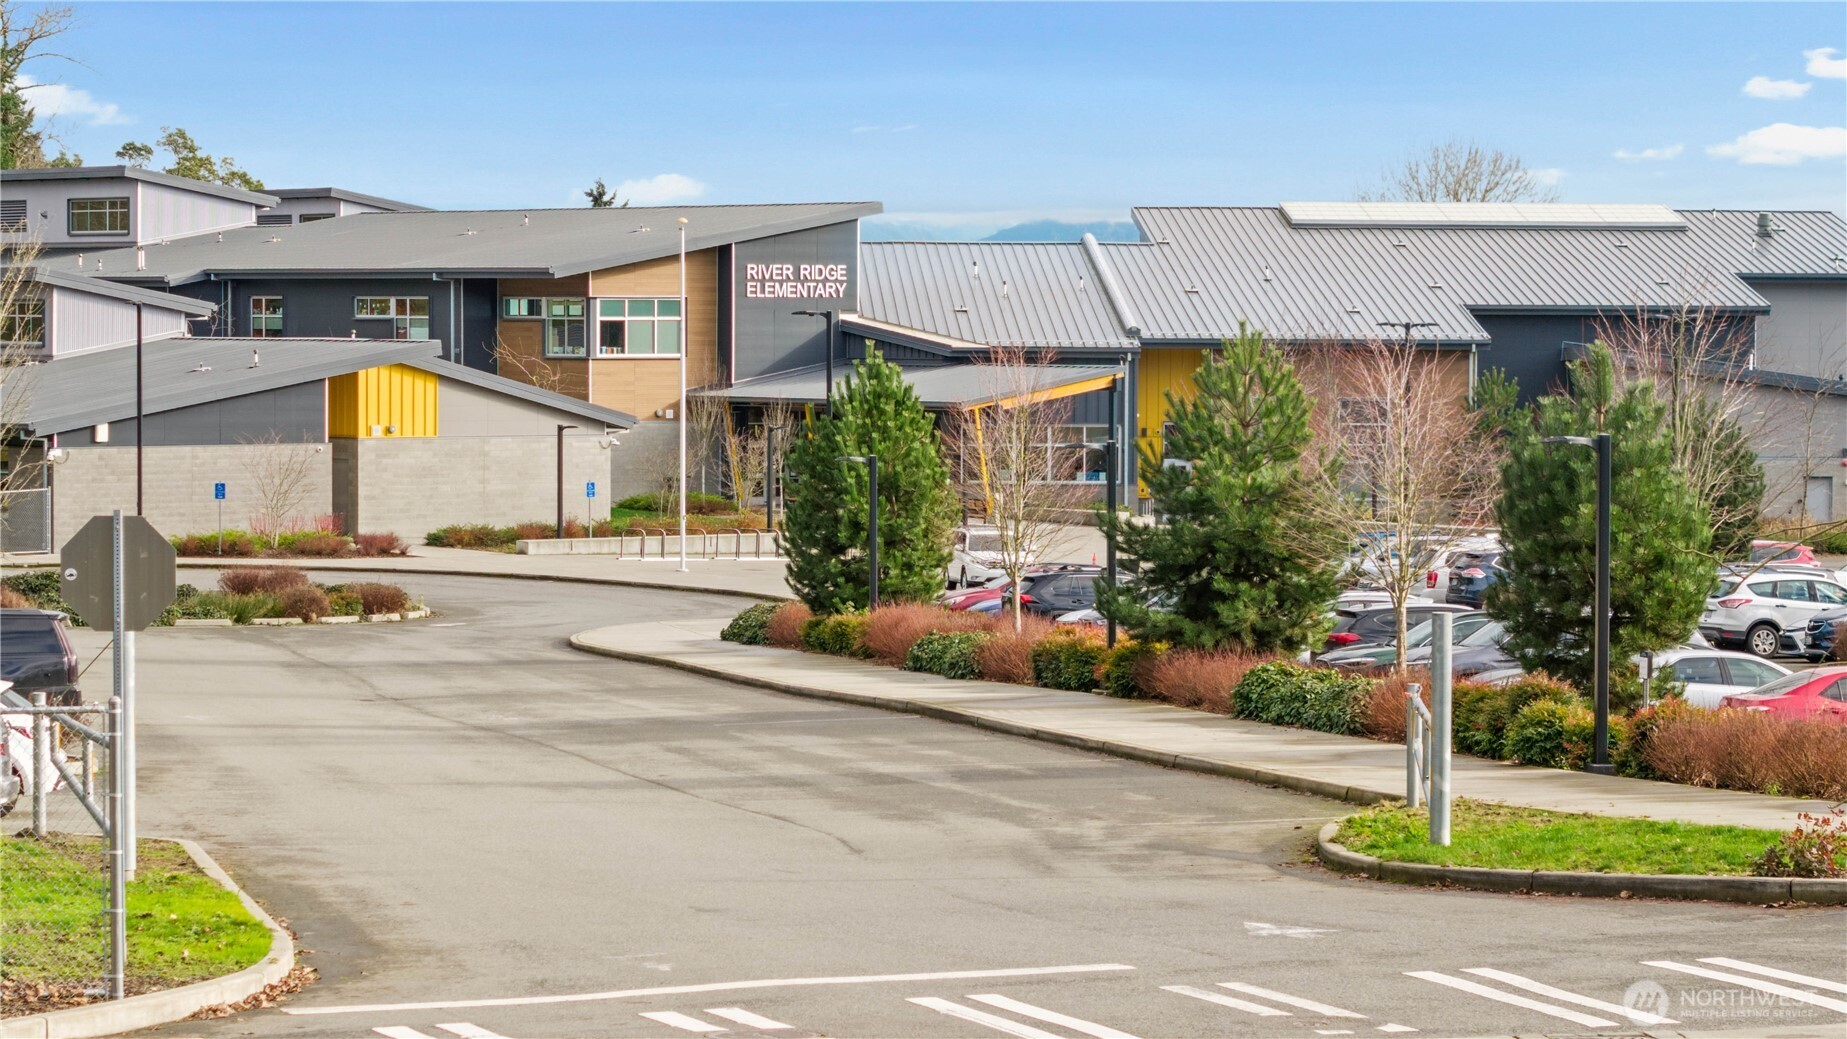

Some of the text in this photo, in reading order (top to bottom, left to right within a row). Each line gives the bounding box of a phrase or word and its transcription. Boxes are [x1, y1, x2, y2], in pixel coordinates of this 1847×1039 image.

[746, 264, 847, 280] RIVER RIDGE
[746, 282, 847, 298] ELEMENTARY
